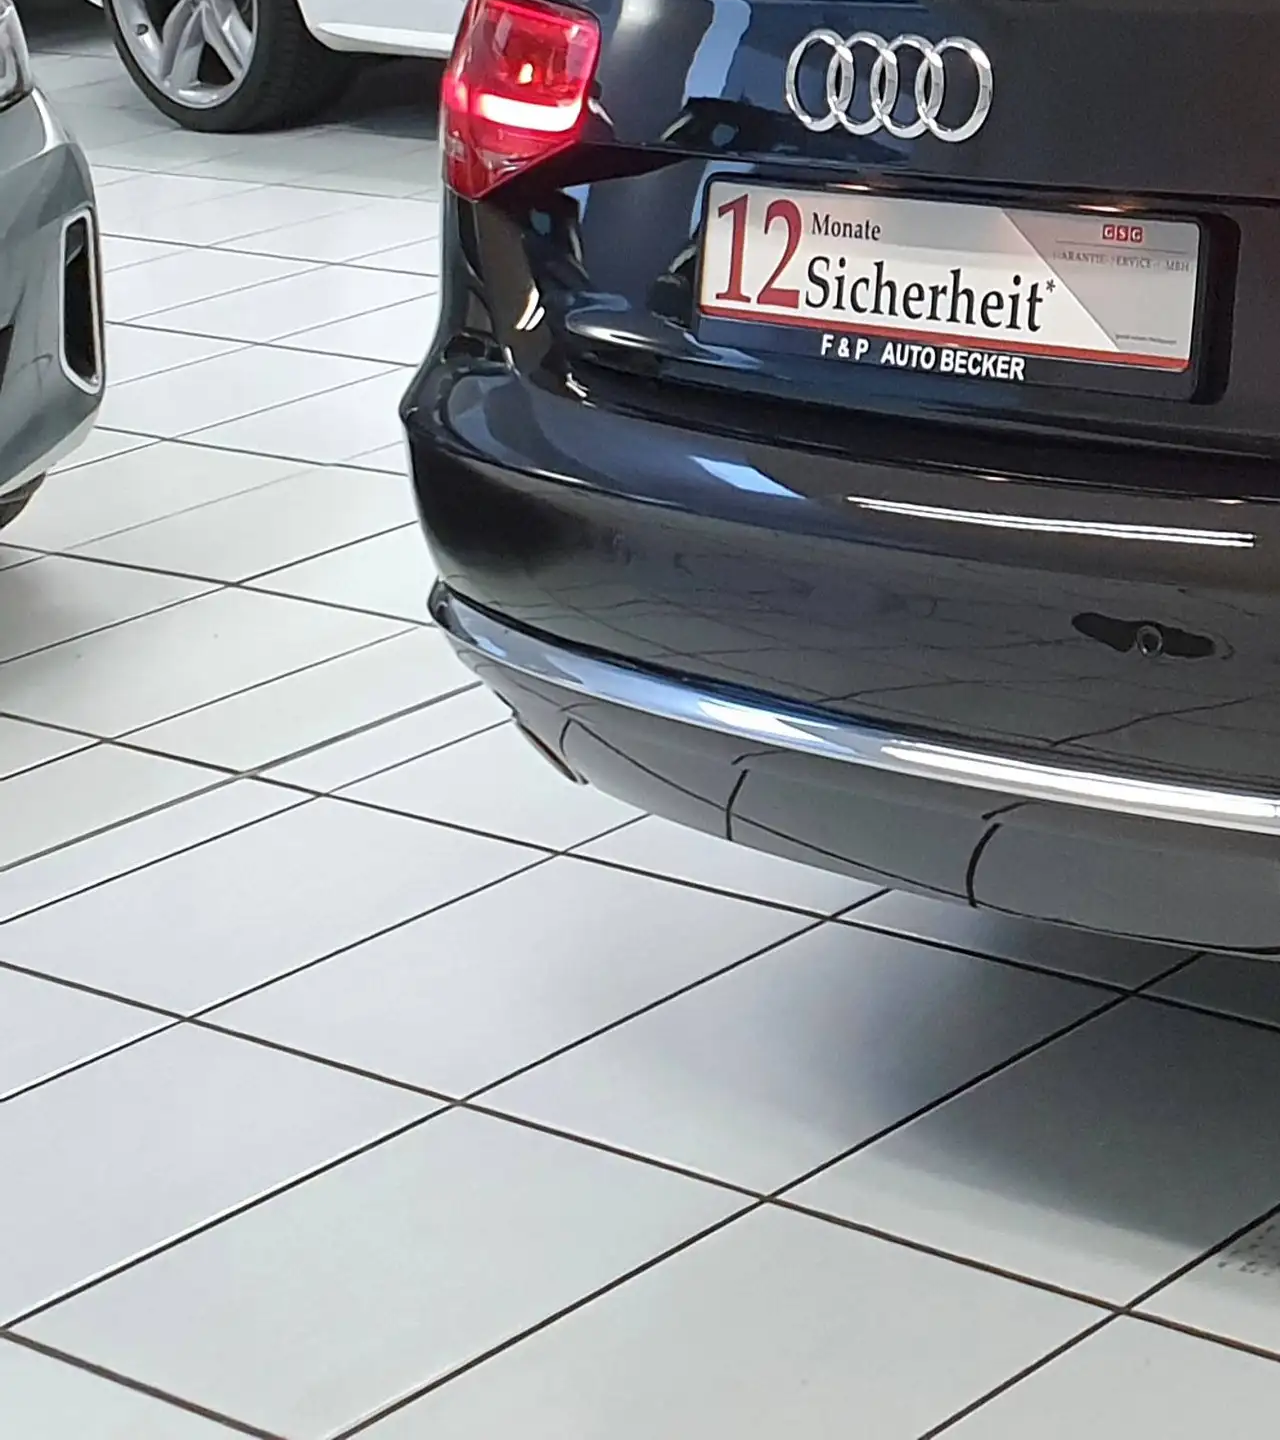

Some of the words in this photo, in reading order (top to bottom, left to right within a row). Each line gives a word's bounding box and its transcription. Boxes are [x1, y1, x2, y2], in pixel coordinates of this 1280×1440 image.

[810, 211, 882, 242] Monate
[1102, 224, 1143, 243] GSG
[714, 193, 802, 309] 12
[820, 333, 834, 356] F
[837, 336, 850, 358] &
[854, 337, 869, 361] P
[880, 341, 936, 370] AUTO
[940, 348, 1025, 382] BECKER
